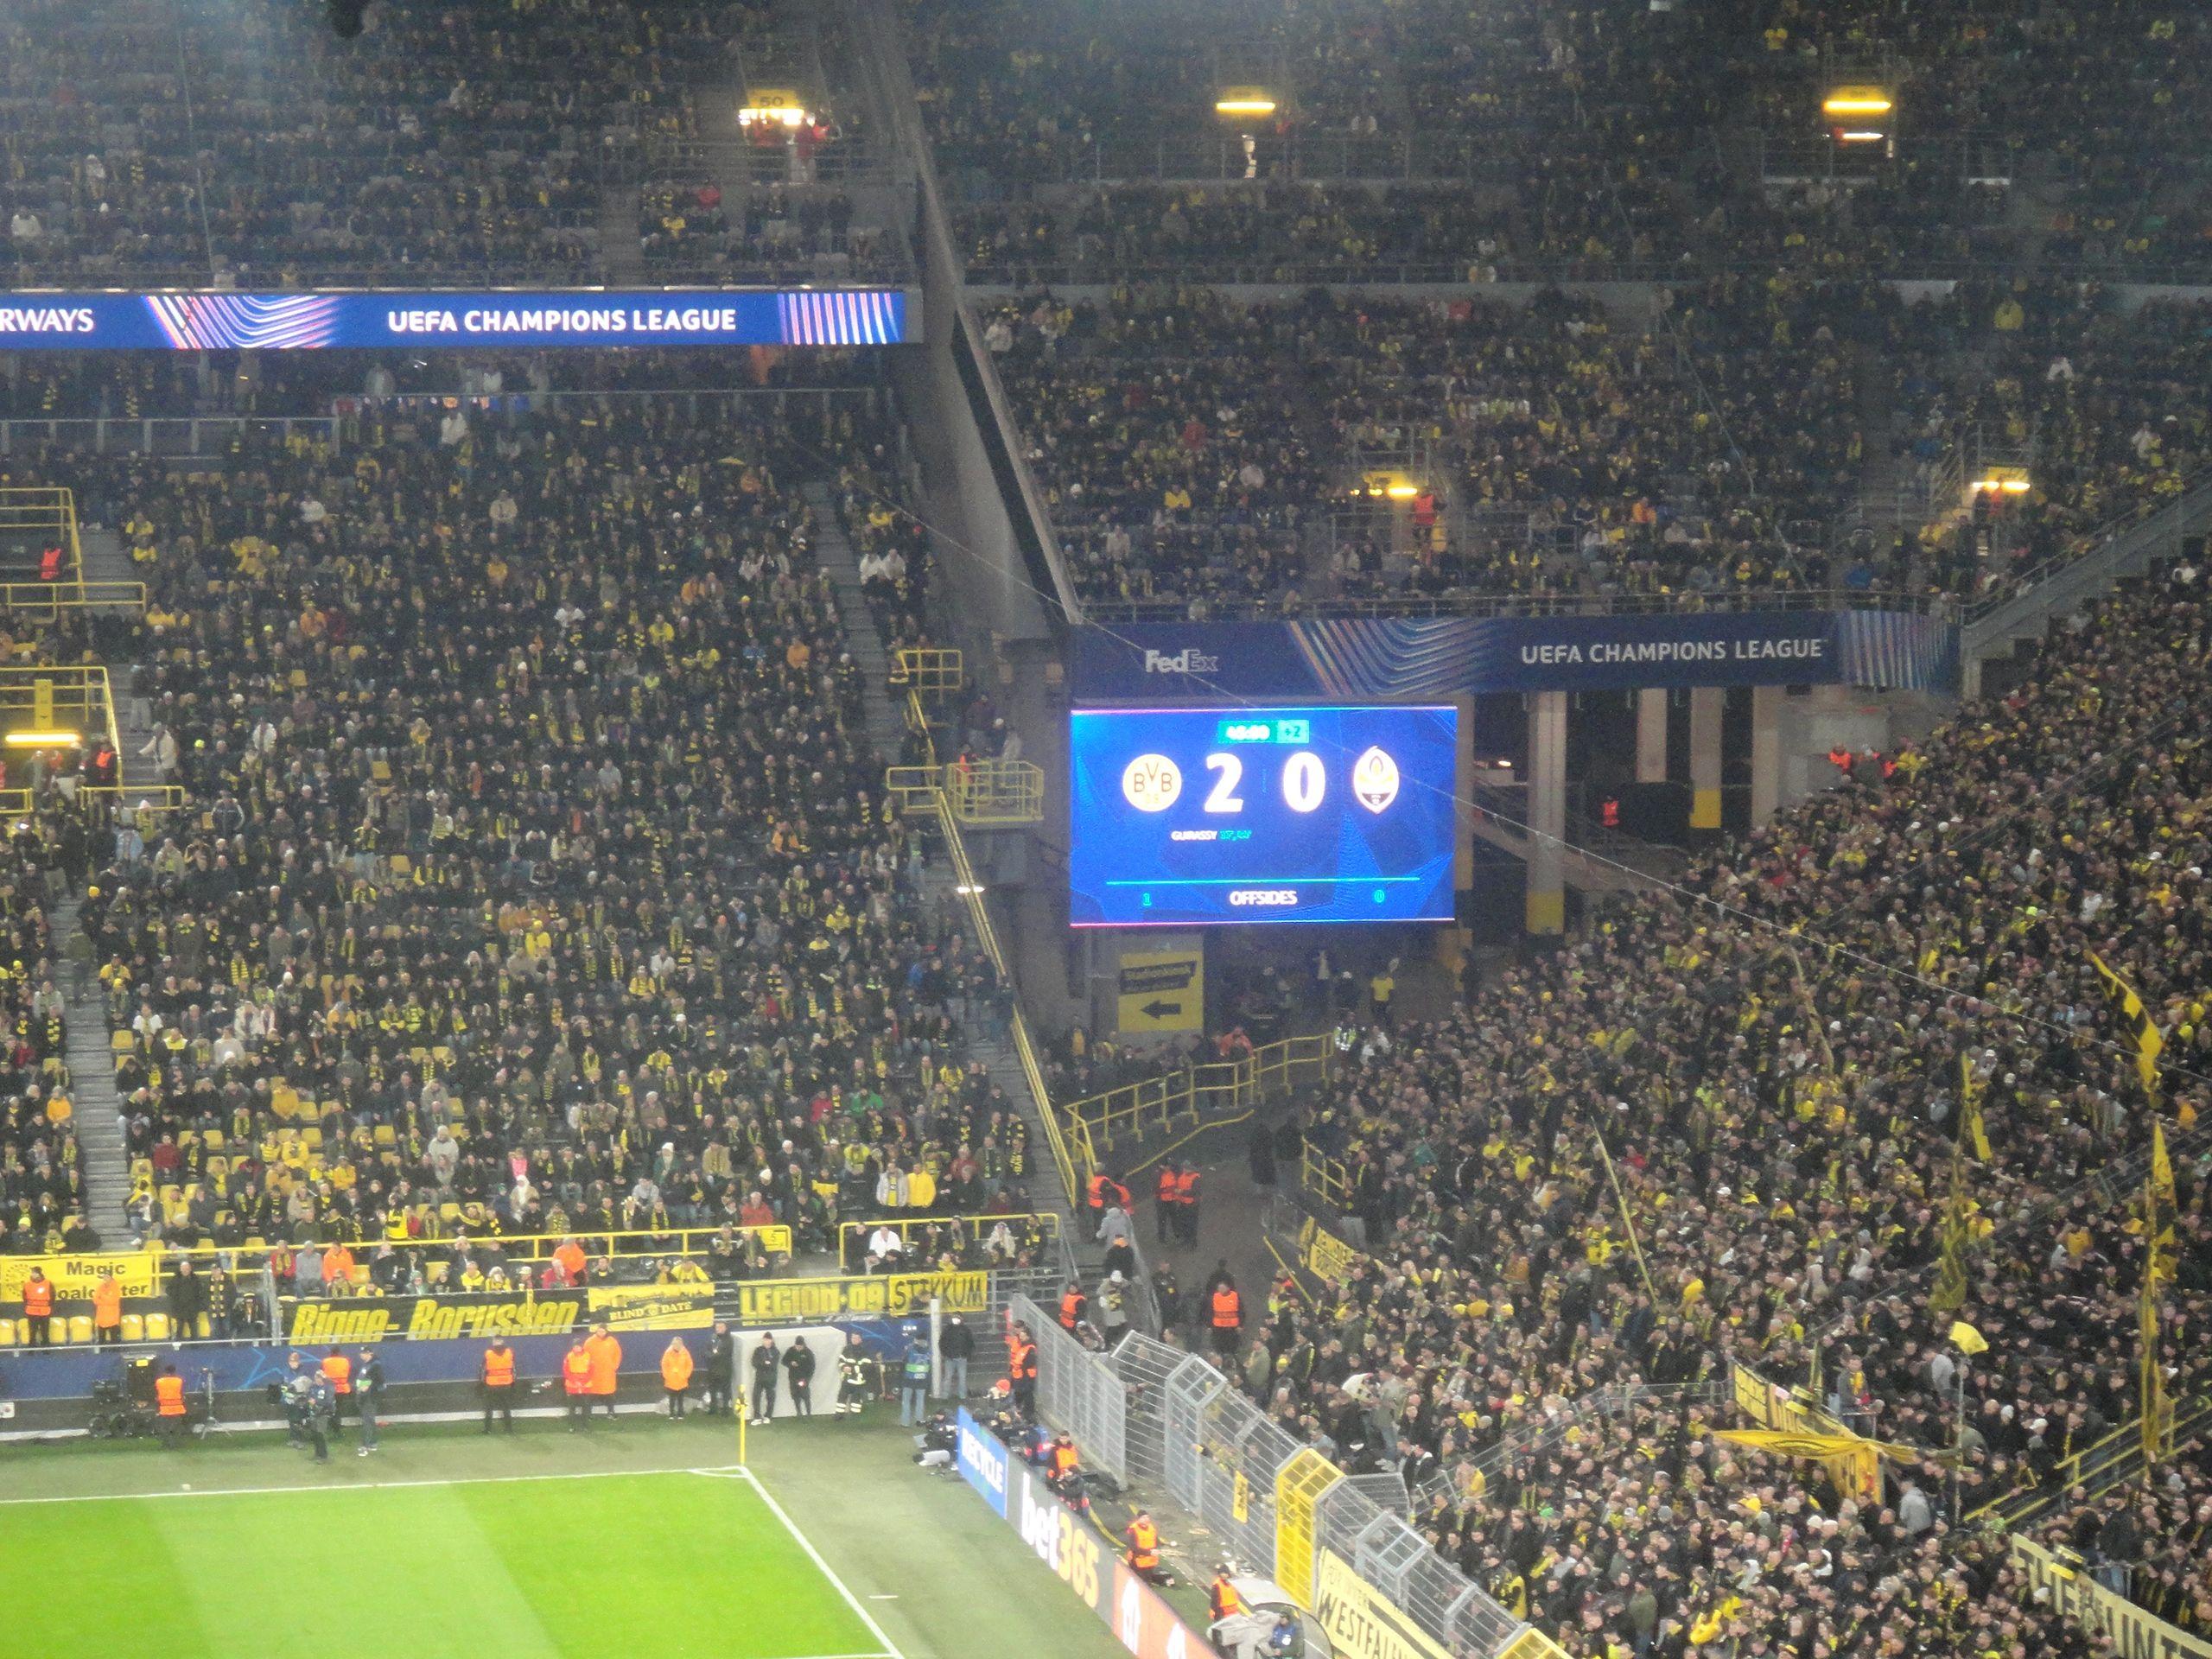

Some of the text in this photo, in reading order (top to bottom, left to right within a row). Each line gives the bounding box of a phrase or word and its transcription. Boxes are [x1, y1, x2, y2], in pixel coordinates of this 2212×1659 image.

[387, 309, 736, 332] UEFA CHAMPIONS LEAGUE
[1146, 649, 1218, 672] FedEx
[1521, 639, 1822, 664] UEFA CHAMPIONS LEAGUE
[1135, 762, 1173, 792] BVB
[1204, 753, 1243, 812] 2
[1283, 752, 1325, 812] 0
[1230, 891, 1297, 906] OFFSIDES
[67, 1262, 126, 1280] Magic
[610, 1301, 692, 1321] BLIND DATE
[740, 1283, 841, 1317] LEGION
[961, 1427, 1004, 1494] RECYCLE
[1021, 1471, 1100, 1608] bet365
